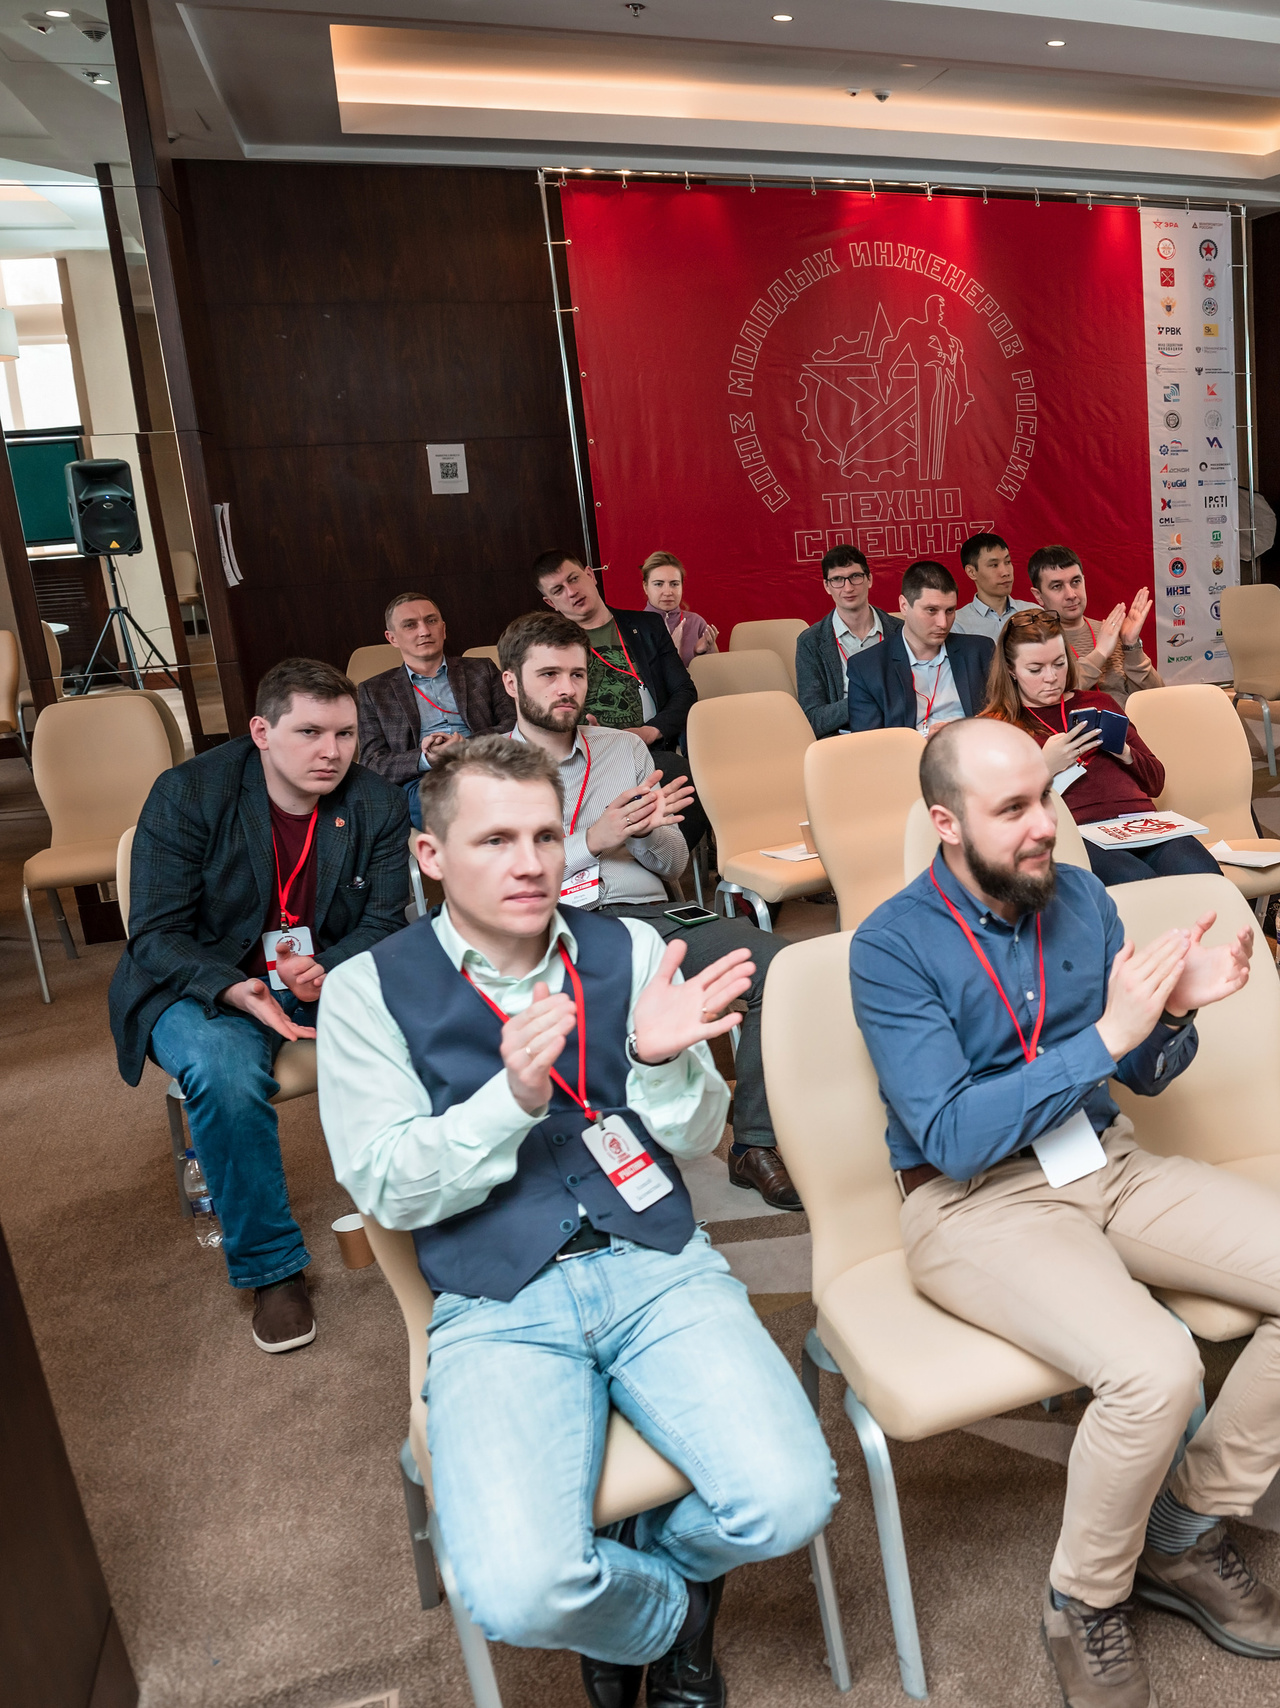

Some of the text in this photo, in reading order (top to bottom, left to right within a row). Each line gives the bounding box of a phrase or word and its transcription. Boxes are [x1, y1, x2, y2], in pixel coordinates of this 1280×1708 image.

[1165, 326, 1182, 336] РВК
[728, 241, 1038, 513] СОЮЗ МОЛОДЫХ ИНЖЕНЕРОВ РОССИИ
[1162, 479, 1187, 488] YouGid
[822, 487, 963, 525] ТЕХНО
